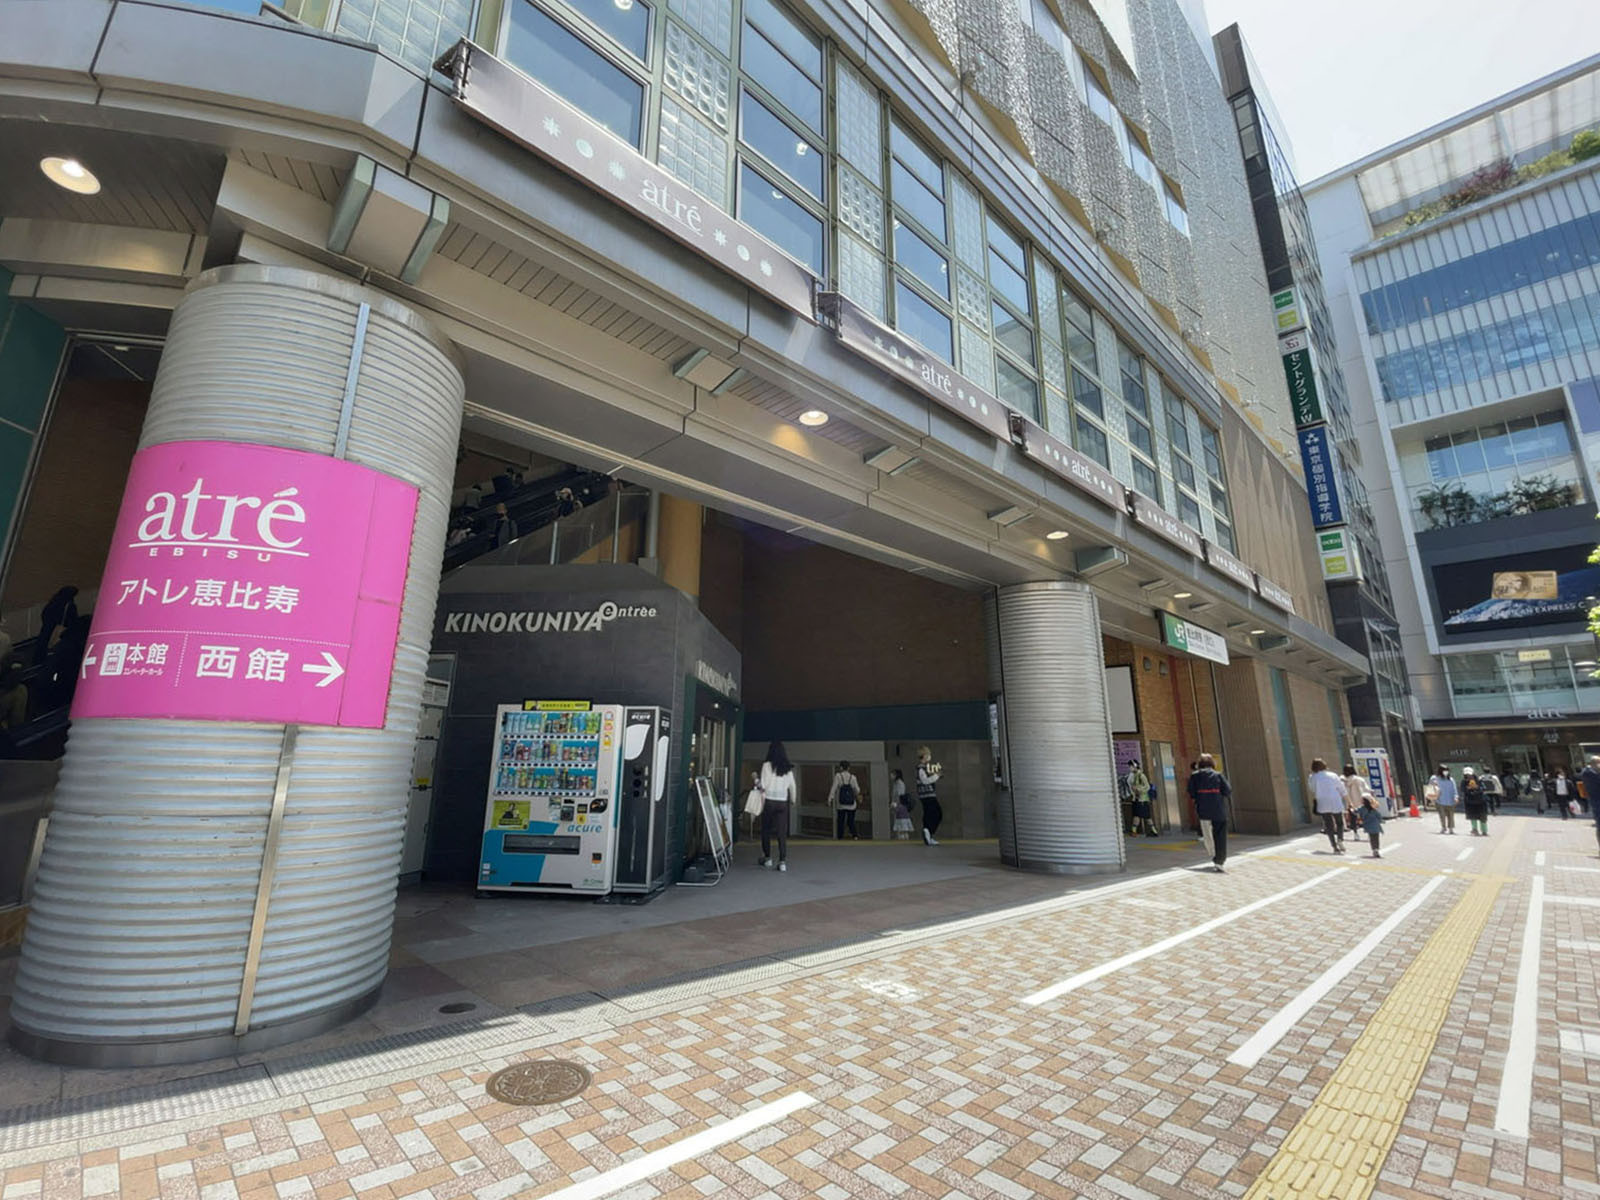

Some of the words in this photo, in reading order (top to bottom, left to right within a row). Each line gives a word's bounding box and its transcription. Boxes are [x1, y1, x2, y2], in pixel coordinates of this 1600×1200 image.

[641, 178, 702, 232] atré
[921, 363, 952, 395] atré
[137, 478, 306, 549] atré
[150, 547, 271, 562] EBISU
[116, 577, 300, 614] アトレ恵比寿
[444, 611, 602, 633] KINOKUNIYA
[126, 643, 169, 665] 本館
[196, 645, 290, 683] 西館
[567, 824, 603, 833] acure
